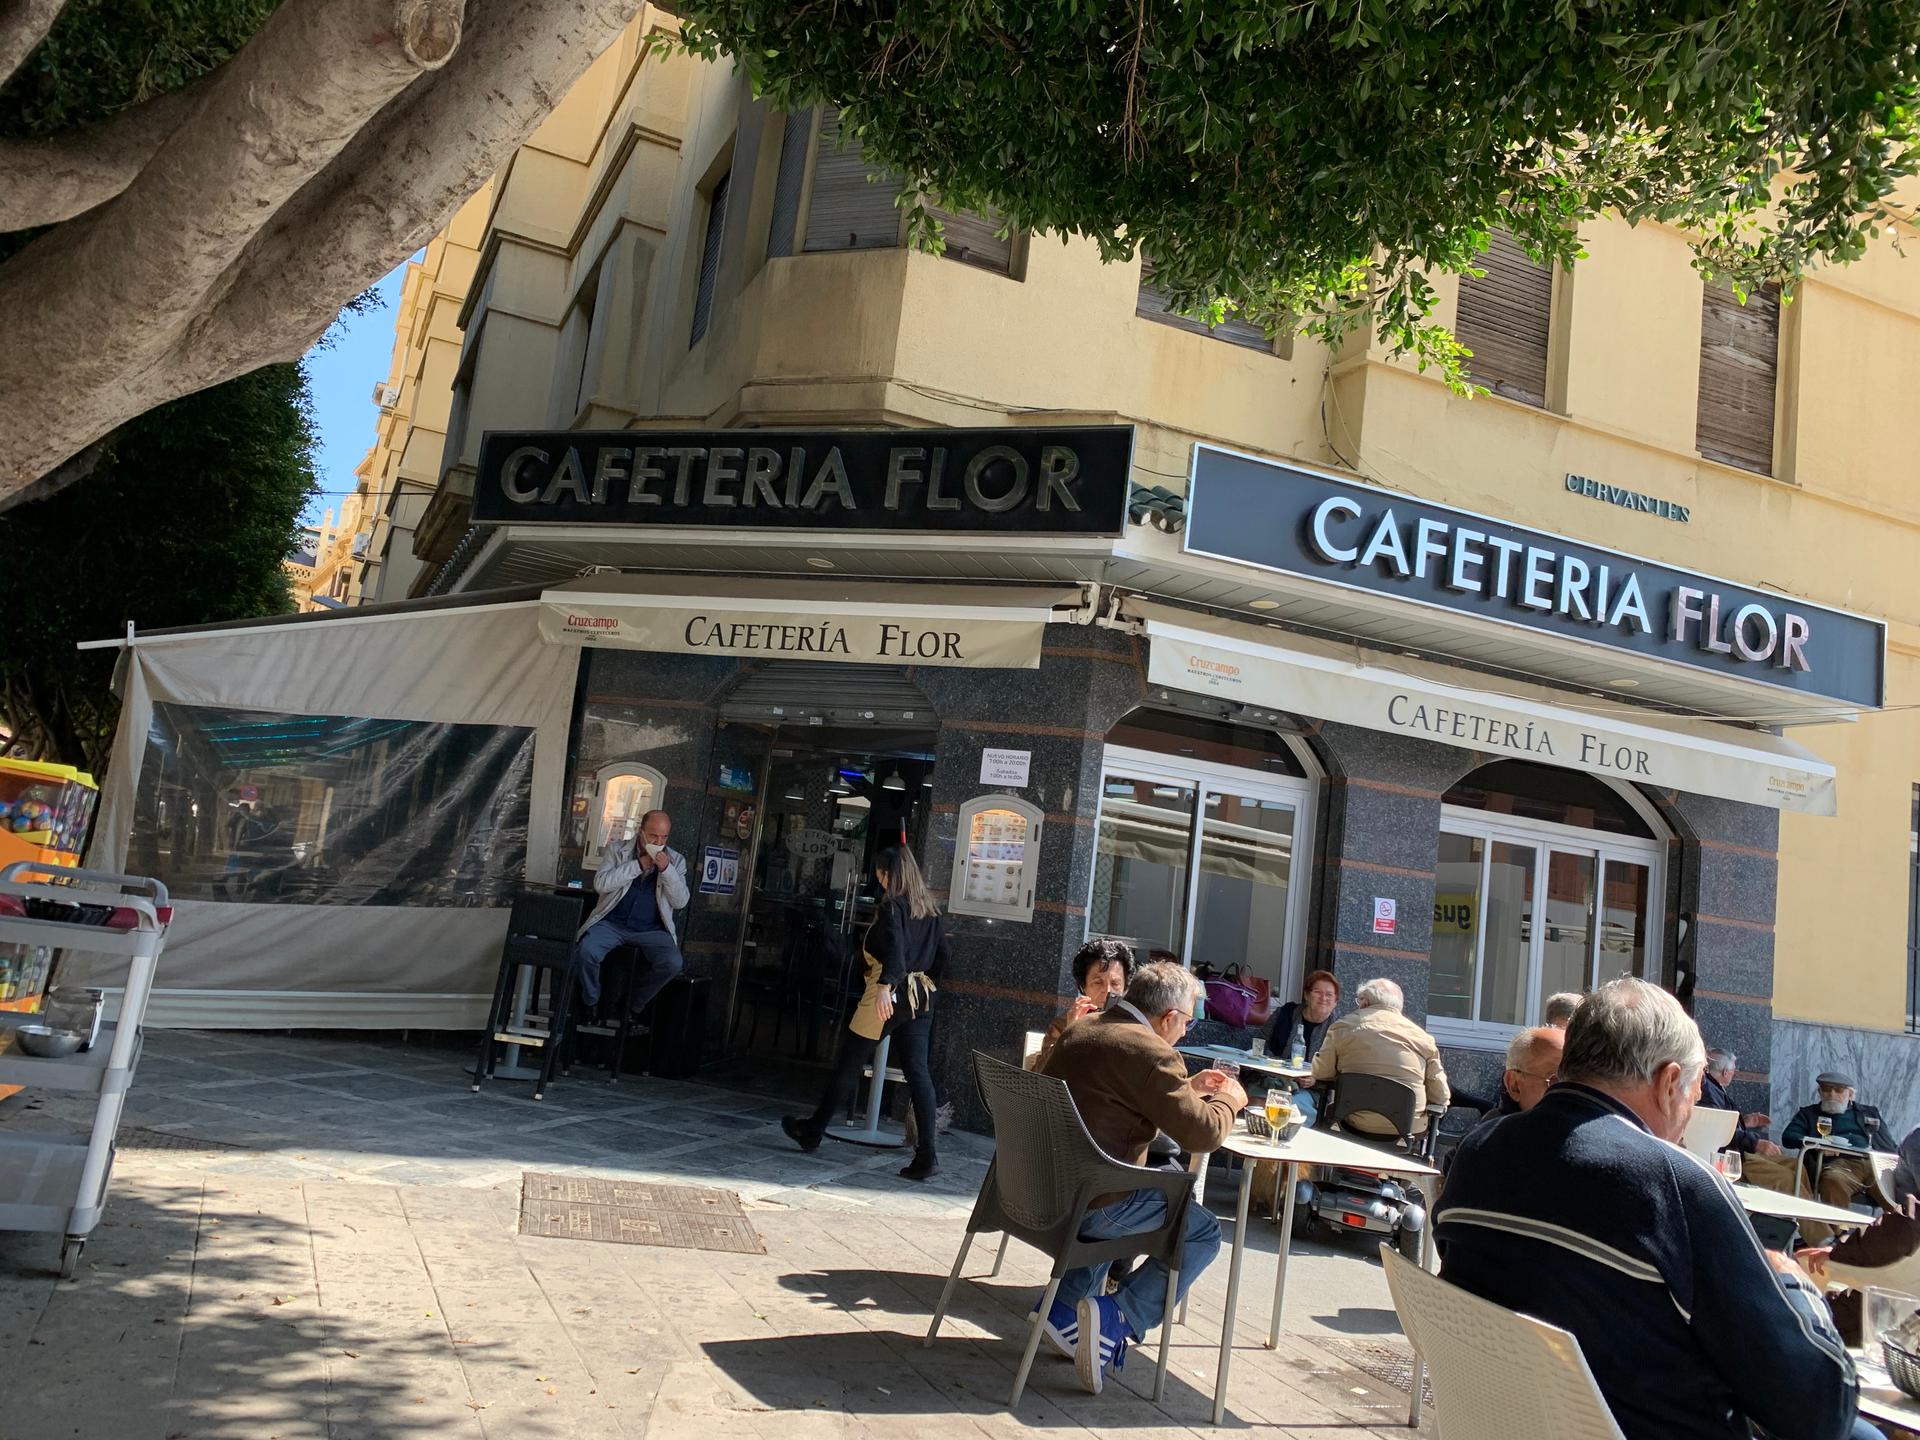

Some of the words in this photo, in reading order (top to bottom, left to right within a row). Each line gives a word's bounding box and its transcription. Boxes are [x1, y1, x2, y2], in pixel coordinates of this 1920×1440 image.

[500, 445, 857, 510] CAFETERIA
[884, 445, 1081, 512] FLOR
[1565, 473, 1690, 523] CERVANTES
[1311, 496, 1652, 634] CAFETERIA
[1673, 586, 1811, 672] FLOR
[568, 614, 618, 629] Cruzcampo
[684, 616, 851, 653] CAFETERÍA
[876, 624, 964, 659] FLOR
[1190, 656, 1240, 676] Cruzcampo
[1388, 695, 1556, 756] CAFETERÍA
[1578, 733, 1651, 775] FLOR
